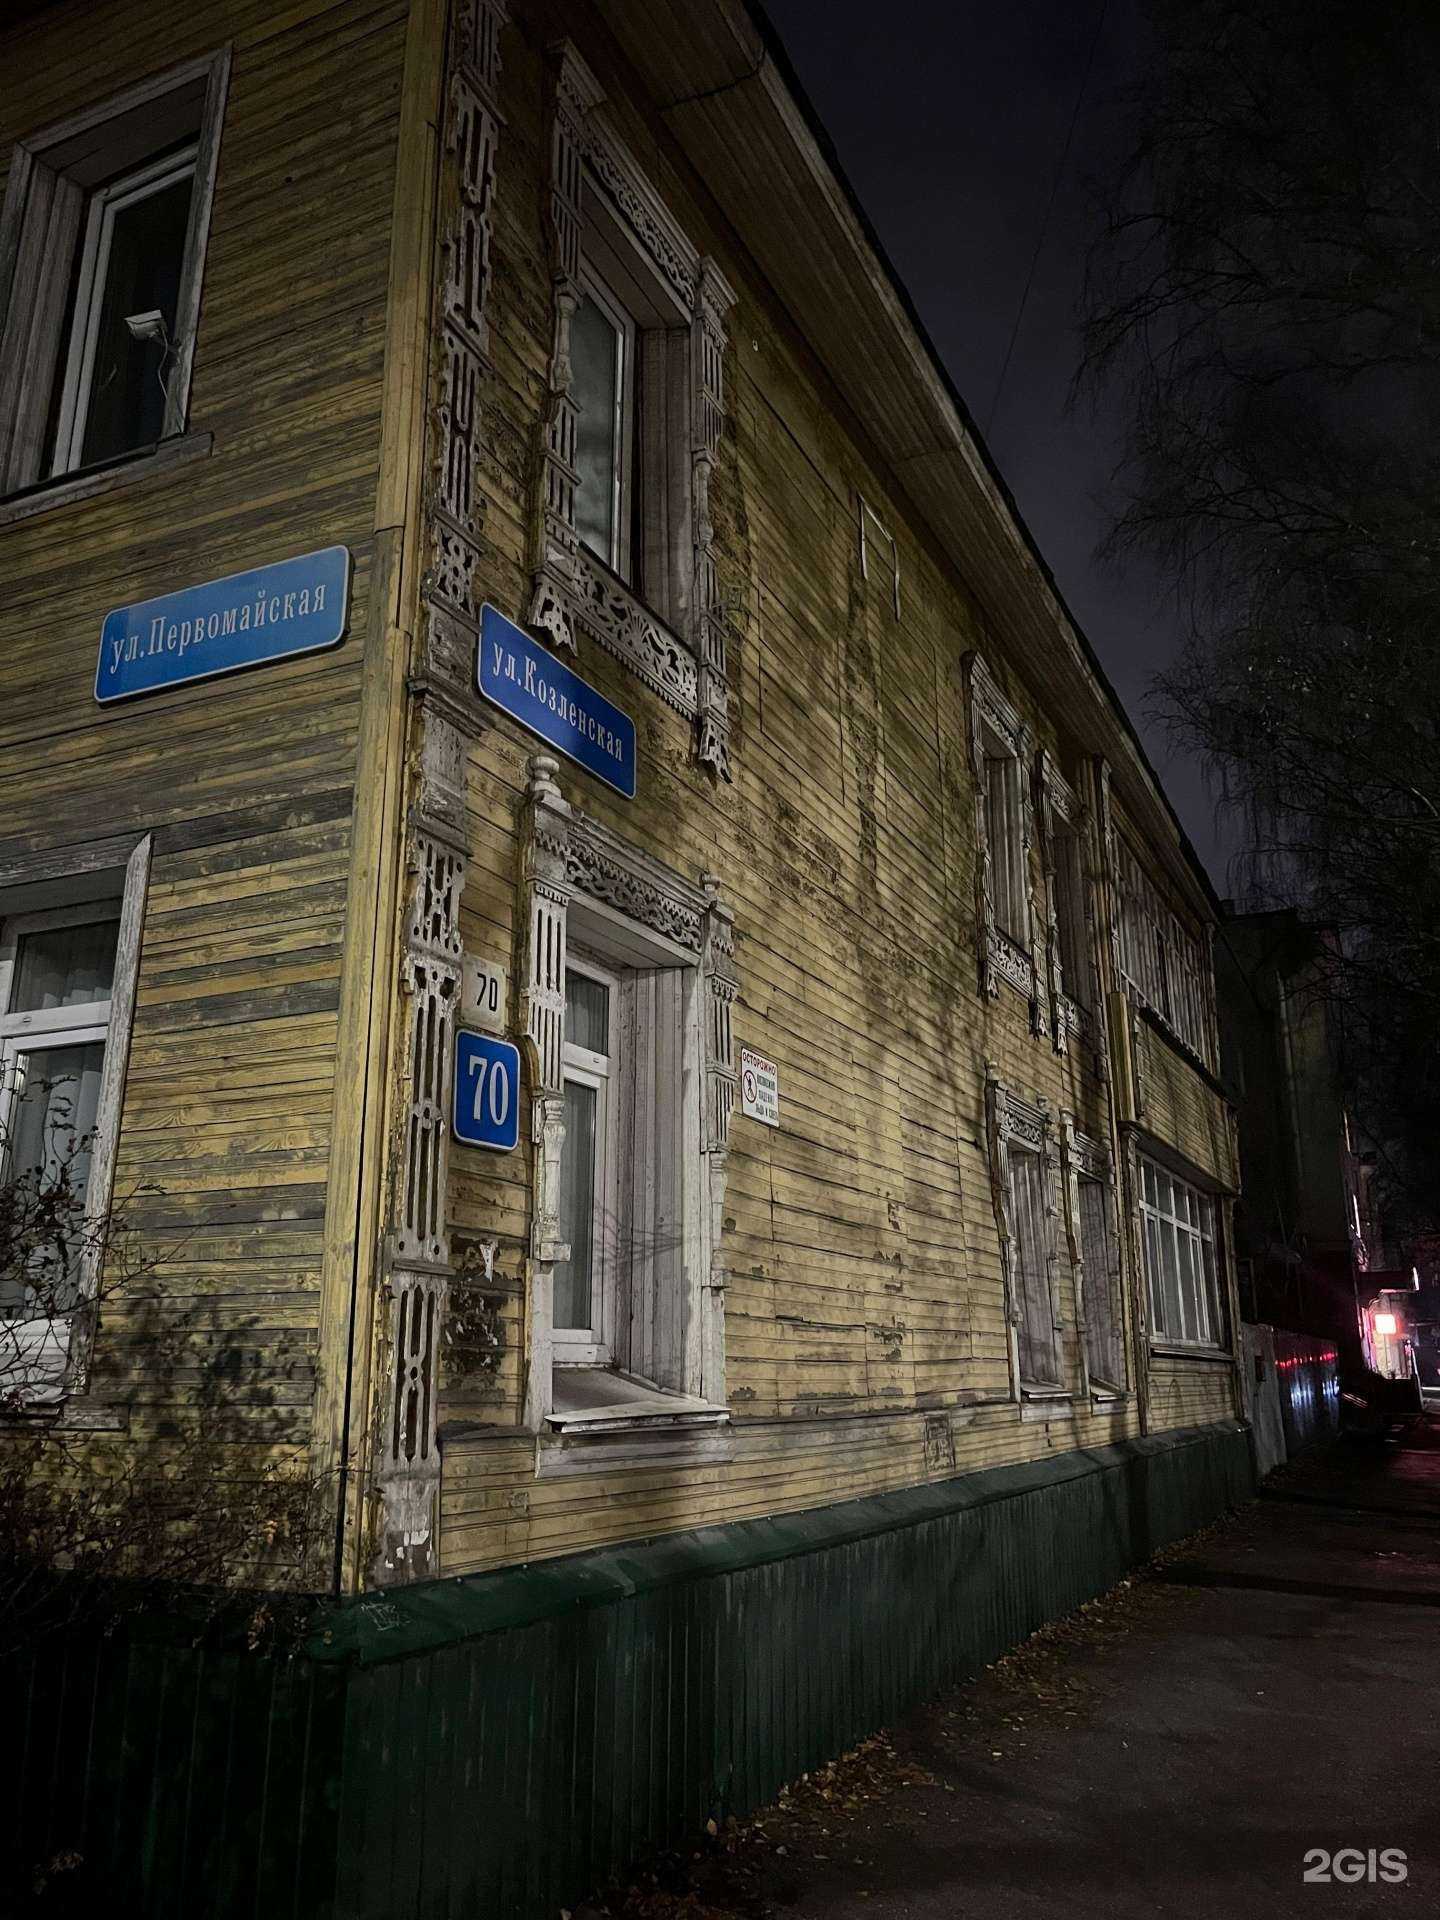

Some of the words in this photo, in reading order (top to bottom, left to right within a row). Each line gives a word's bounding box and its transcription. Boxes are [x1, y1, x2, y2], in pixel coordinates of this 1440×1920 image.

[110, 584, 326, 675] ул.Первомайская
[493, 643, 623, 762] ул.Козленская
[476, 971, 498, 1012] 70
[469, 1054, 509, 1126] 70
